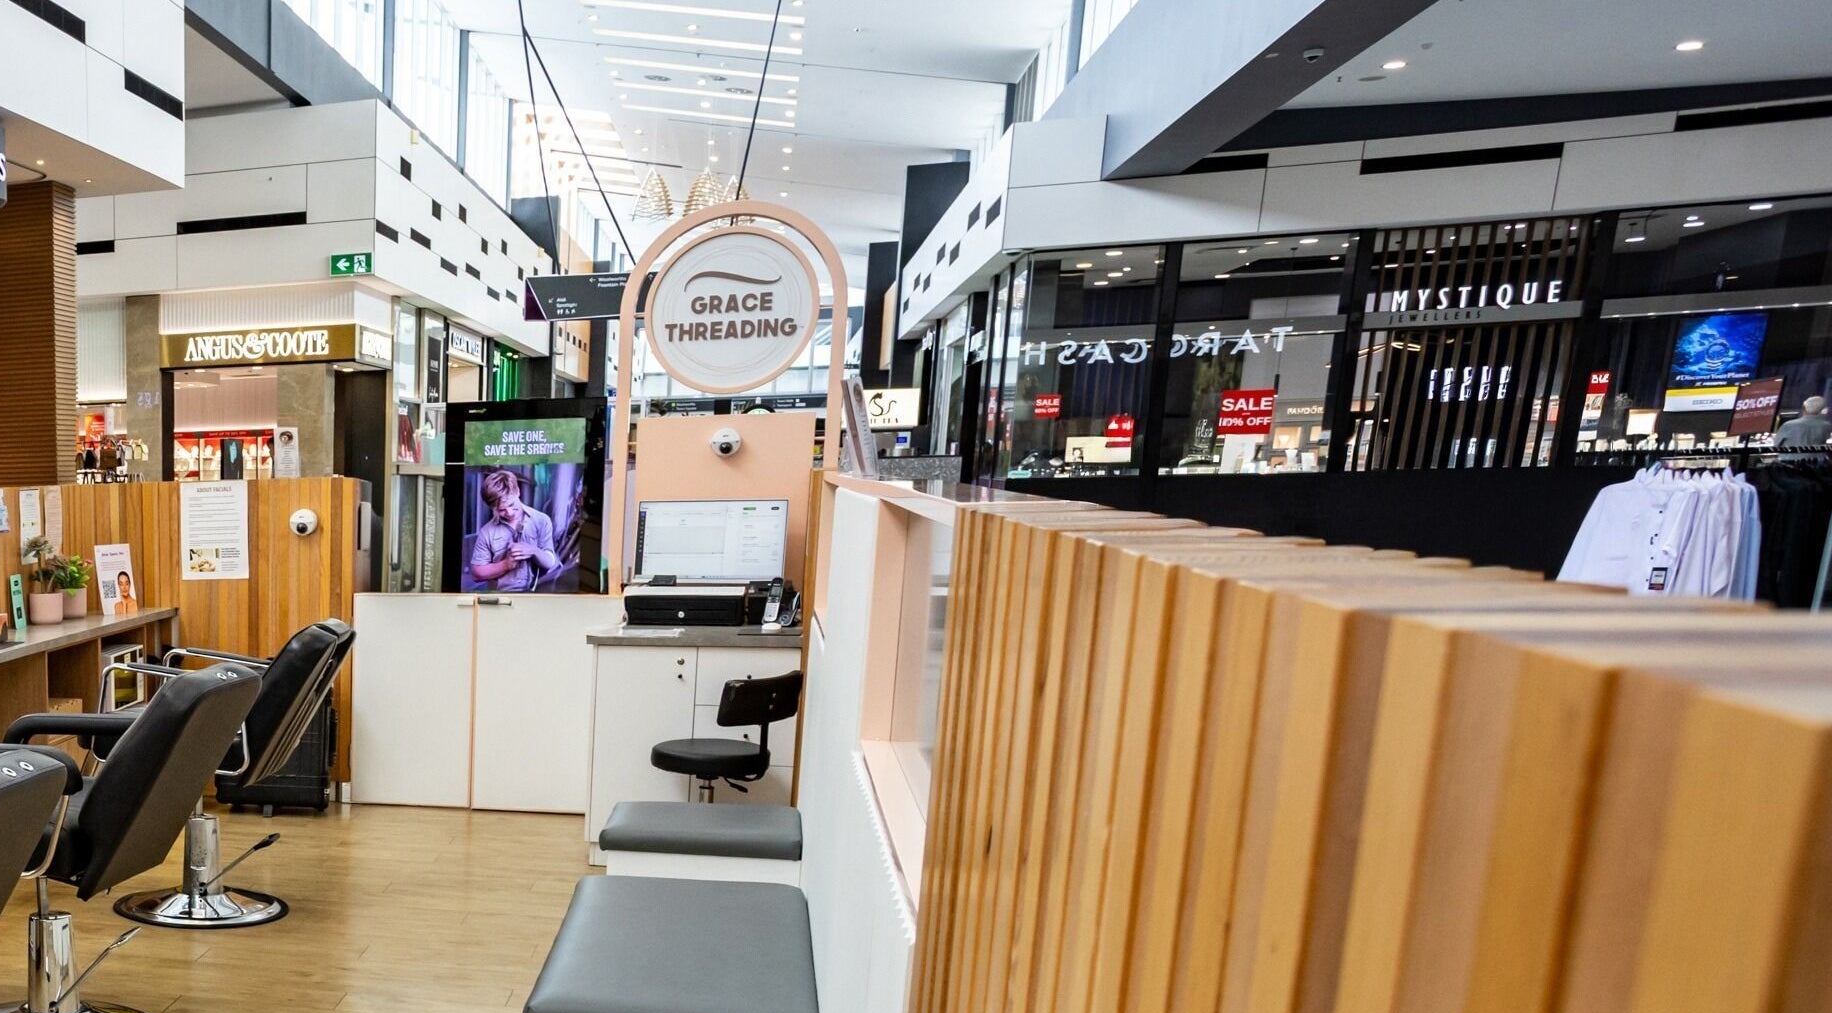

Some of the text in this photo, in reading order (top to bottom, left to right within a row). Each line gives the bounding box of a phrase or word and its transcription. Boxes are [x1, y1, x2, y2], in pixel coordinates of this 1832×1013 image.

[1391, 280, 1563, 311] MYSTIQUE
[691, 292, 773, 315] GRACE
[1389, 310, 1482, 325] JEWELLERS
[665, 318, 798, 342] THREADING
[1035, 398, 1060, 406] SALE
[1222, 397, 1273, 411] SALE
[1756, 396, 1779, 408] OFF
[1246, 416, 1272, 426] OFF
[502, 430, 547, 443] SAVE ONE,
[484, 444, 507, 457] SAVE
[508, 444, 526, 456] THE
